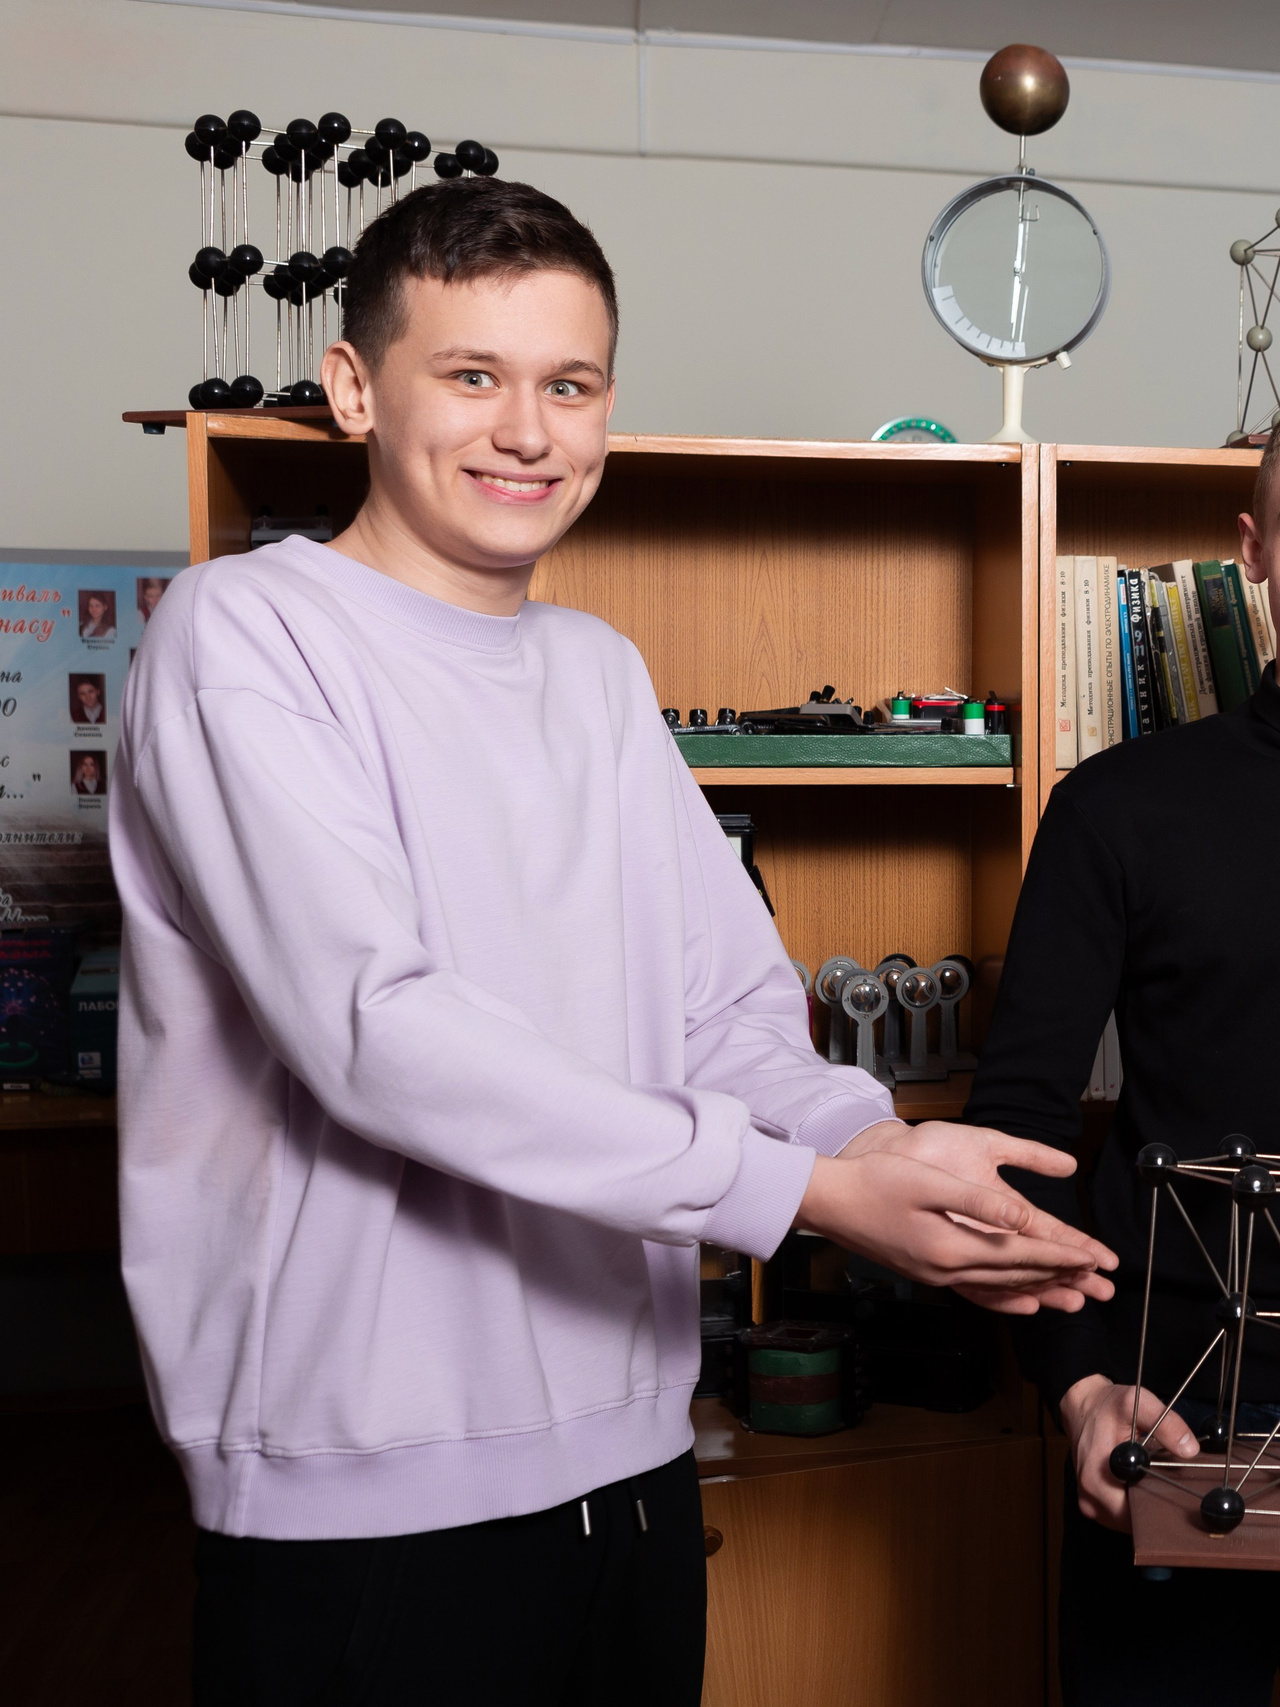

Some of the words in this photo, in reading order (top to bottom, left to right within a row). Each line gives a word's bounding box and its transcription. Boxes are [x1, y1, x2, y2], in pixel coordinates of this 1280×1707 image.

[1103, 564, 1112, 636] ЭЛЕКТРОДИНАМИКЕ
[1129, 578, 1143, 623] Физика
[1181, 575, 1194, 622] эксперимент
[1249, 586, 1260, 615] физике
[1256, 617, 1262, 627] по
[1105, 638, 1112, 650] ПО
[1134, 630, 1142, 642] 9
[1257, 630, 1268, 656] работа
[1086, 630, 1094, 678] преподавания
[1105, 652, 1113, 678] ОПЫТЫ
[1189, 623, 1209, 695] Демонстрационный
[78, 1001, 119, 1012] ЛАБО
